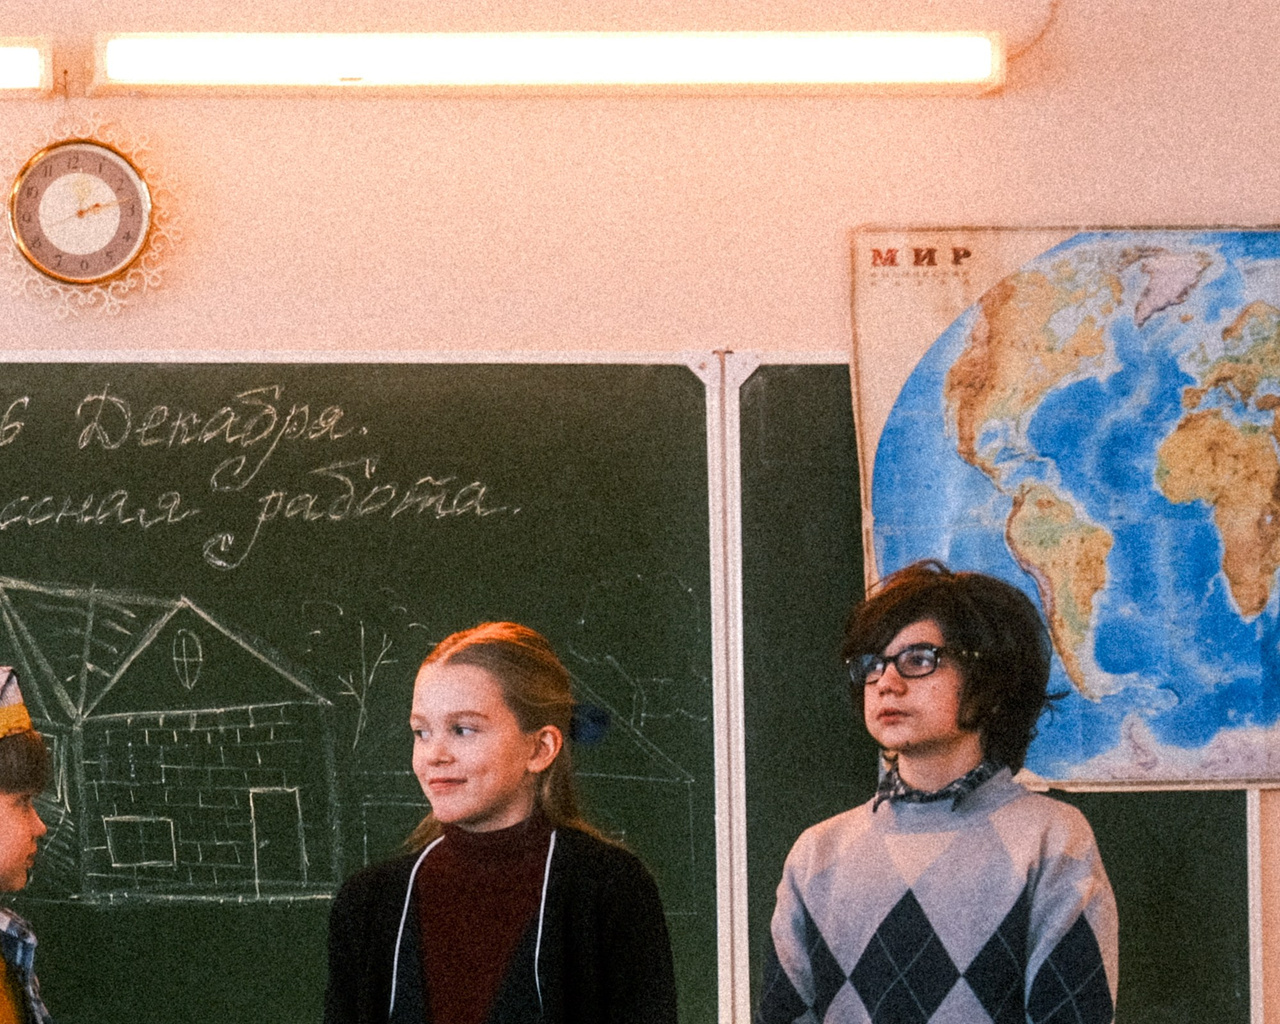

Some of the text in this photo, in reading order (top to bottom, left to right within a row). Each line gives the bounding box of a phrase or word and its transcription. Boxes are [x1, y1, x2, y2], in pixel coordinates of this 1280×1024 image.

[67, 156, 80, 170] 12
[44, 165, 53, 177] 11
[116, 179, 125, 191] 2
[22, 213, 32, 224] 9
[122, 231, 132, 242] 4
[53, 254, 63, 267] 7
[105, 251, 114, 262] 5
[871, 247, 972, 267] МИР
